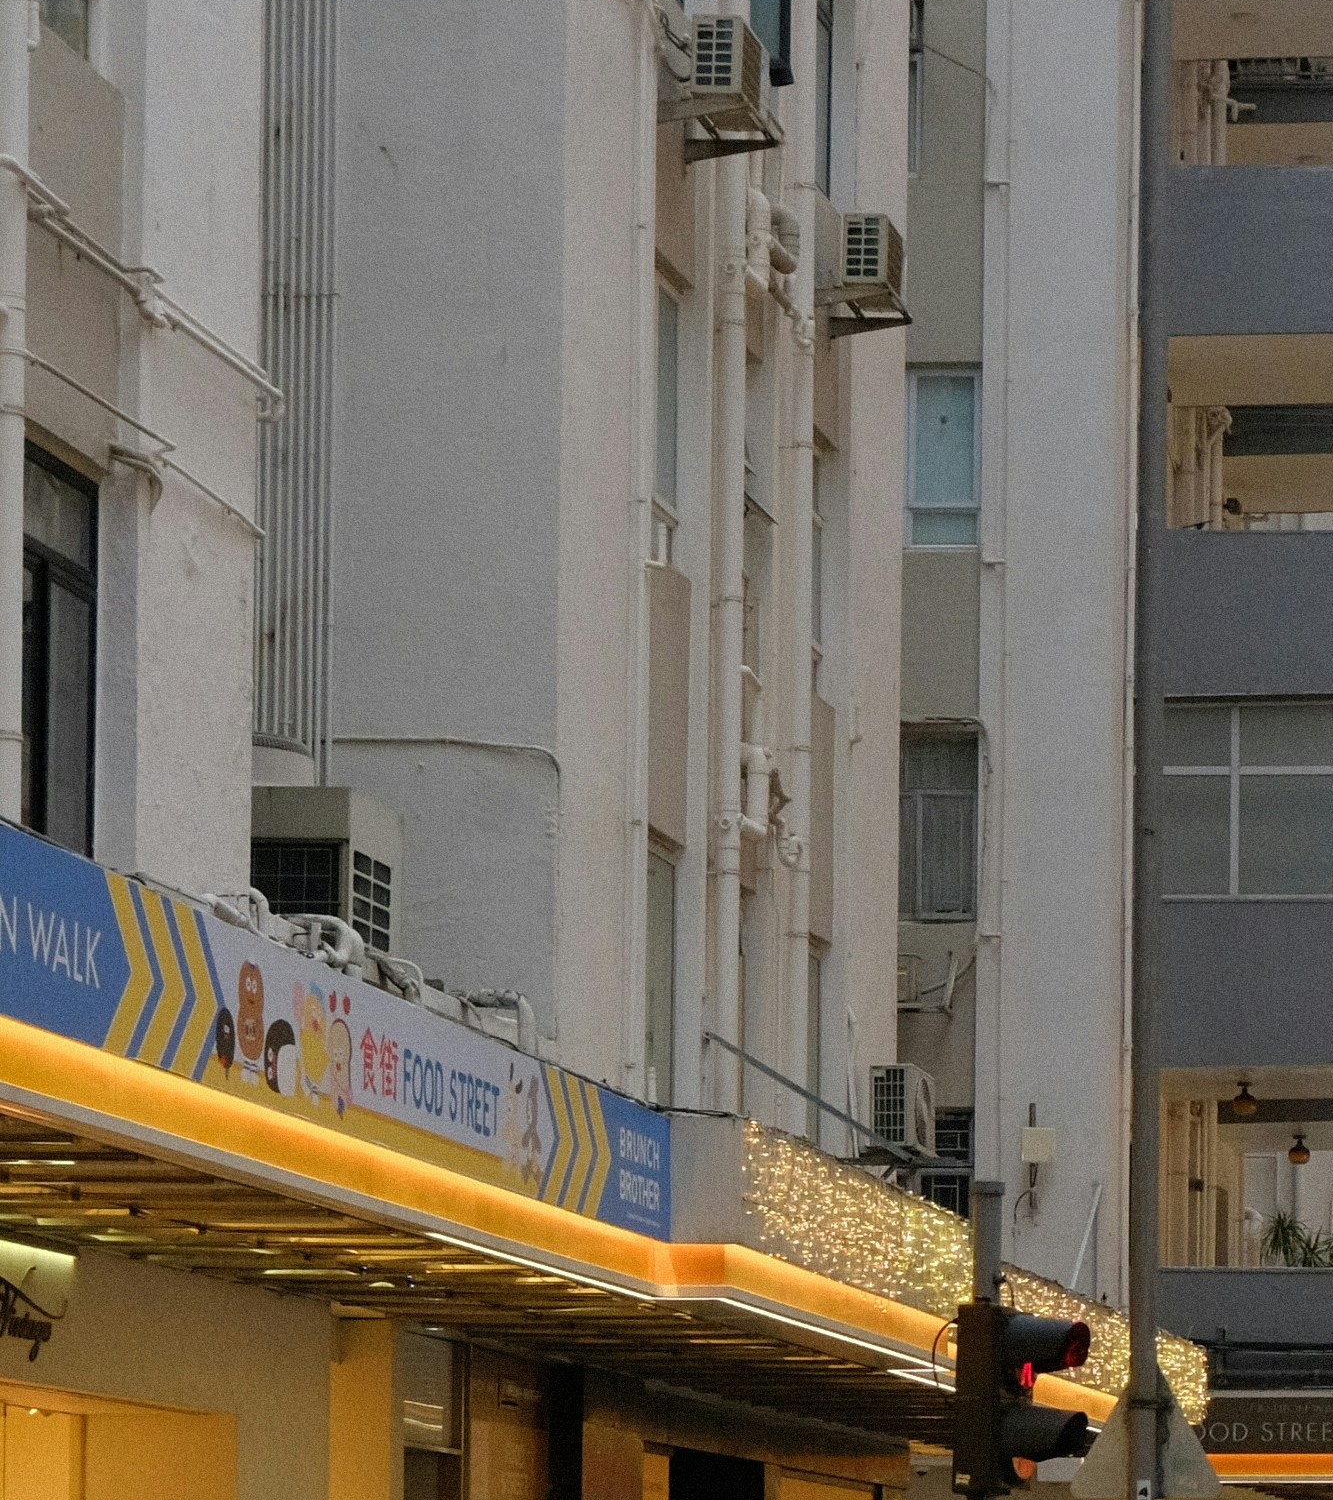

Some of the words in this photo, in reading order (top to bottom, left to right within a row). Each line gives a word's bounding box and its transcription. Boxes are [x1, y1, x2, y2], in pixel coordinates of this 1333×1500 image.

[27, 901, 102, 989] WALK
[359, 1026, 399, 1102] 食街
[403, 1048, 444, 1117] FOOD
[449, 1068, 500, 1137] STREET
[620, 1126, 660, 1171] BRUNCH
[620, 1168, 660, 1212] BROTHER
[1200, 1421, 1249, 1442] OD
